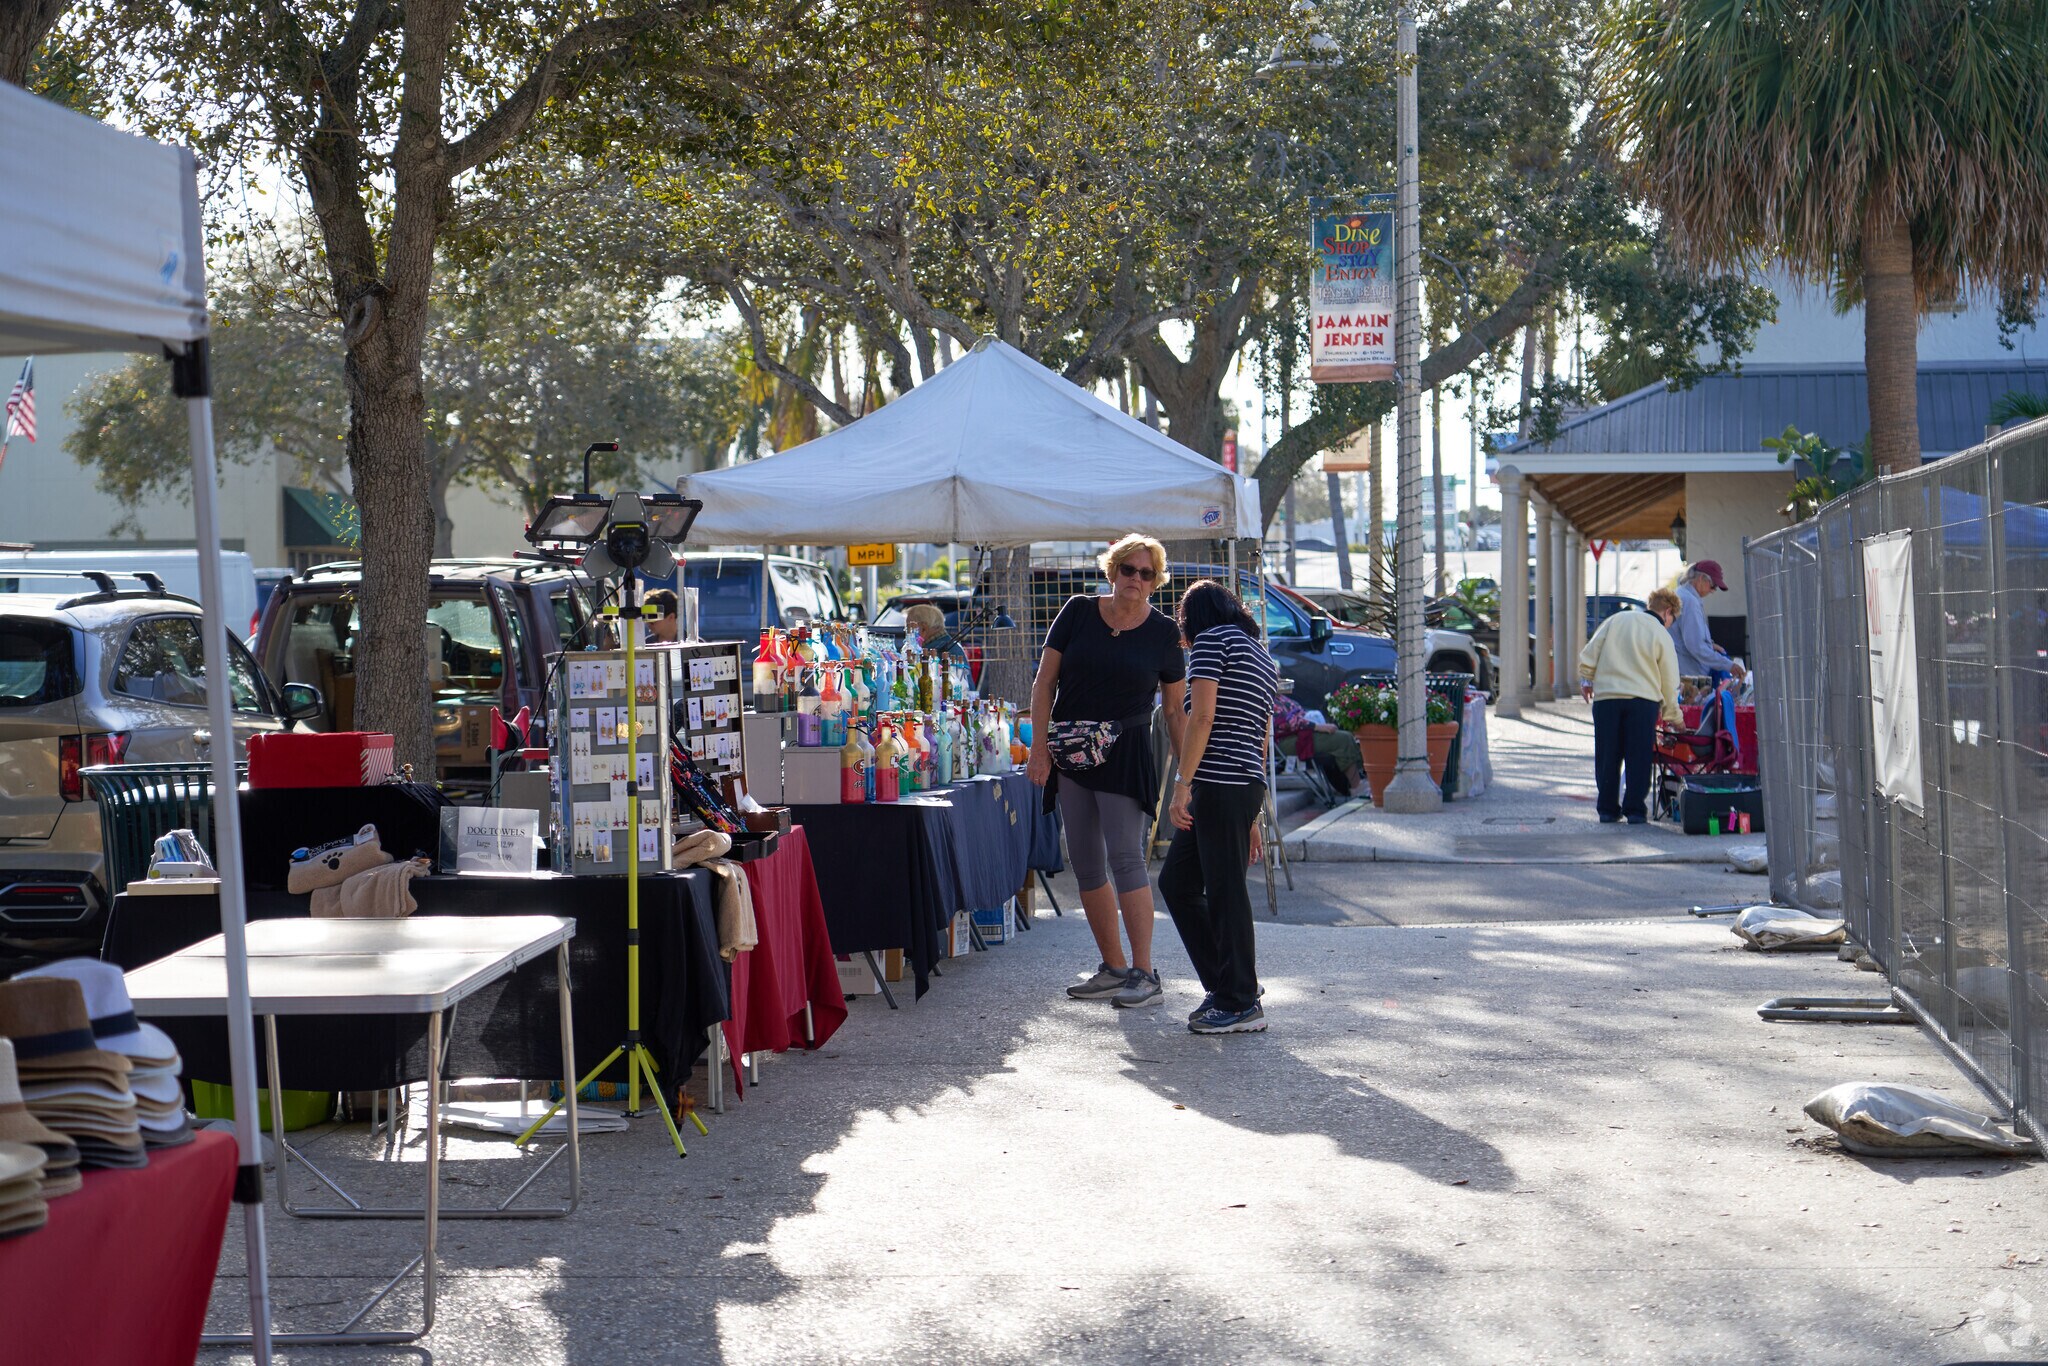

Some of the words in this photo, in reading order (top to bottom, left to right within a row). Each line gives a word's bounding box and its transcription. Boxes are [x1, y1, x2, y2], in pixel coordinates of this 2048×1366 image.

[1317, 286, 1355, 301] JENSEN
[1359, 284, 1390, 299] BEACH
[1316, 313, 1392, 329] JAMMIN'
[1324, 332, 1384, 347] JENSEN
[857, 550, 885, 560] MPH
[467, 826, 487, 835] DOG
[489, 827, 526, 837] TOWELS
